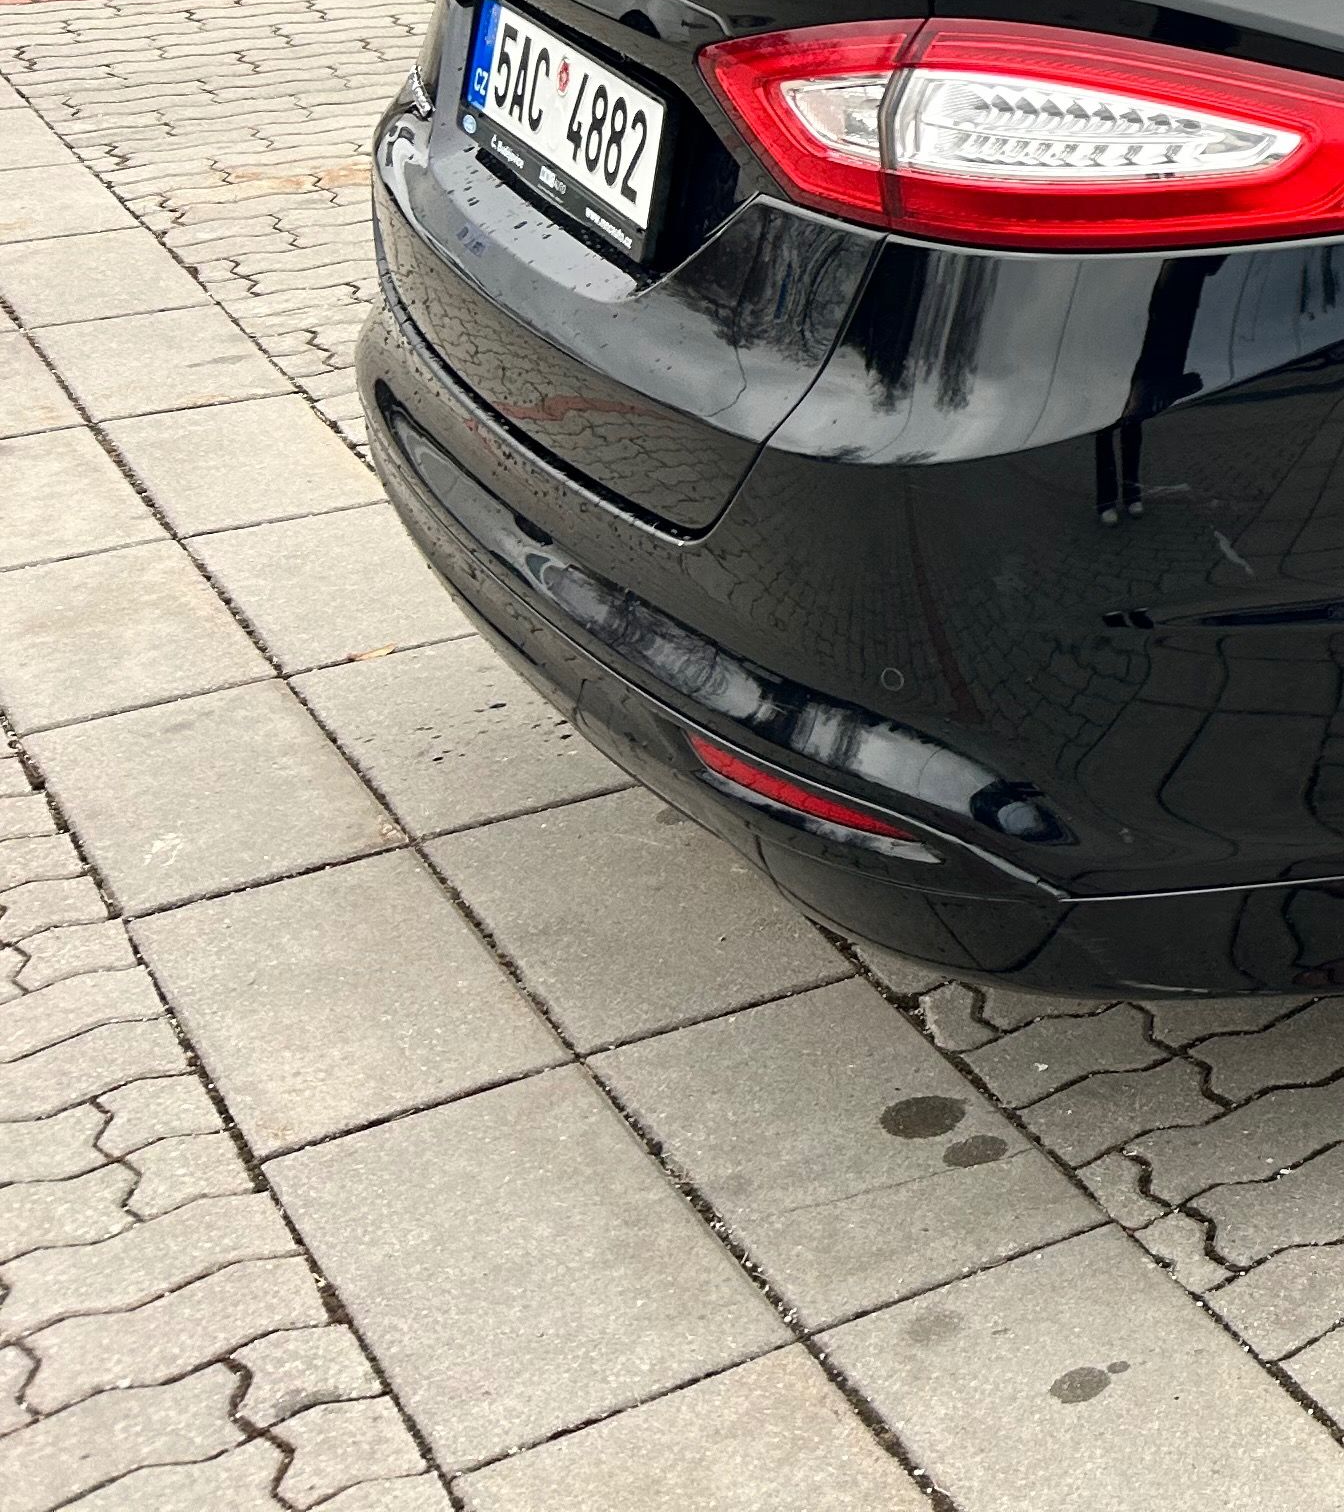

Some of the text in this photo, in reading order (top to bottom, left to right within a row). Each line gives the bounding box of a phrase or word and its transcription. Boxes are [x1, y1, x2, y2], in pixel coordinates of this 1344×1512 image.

[473, 67, 489, 97] CZ
[494, 22, 648, 205] 5AC 4882
